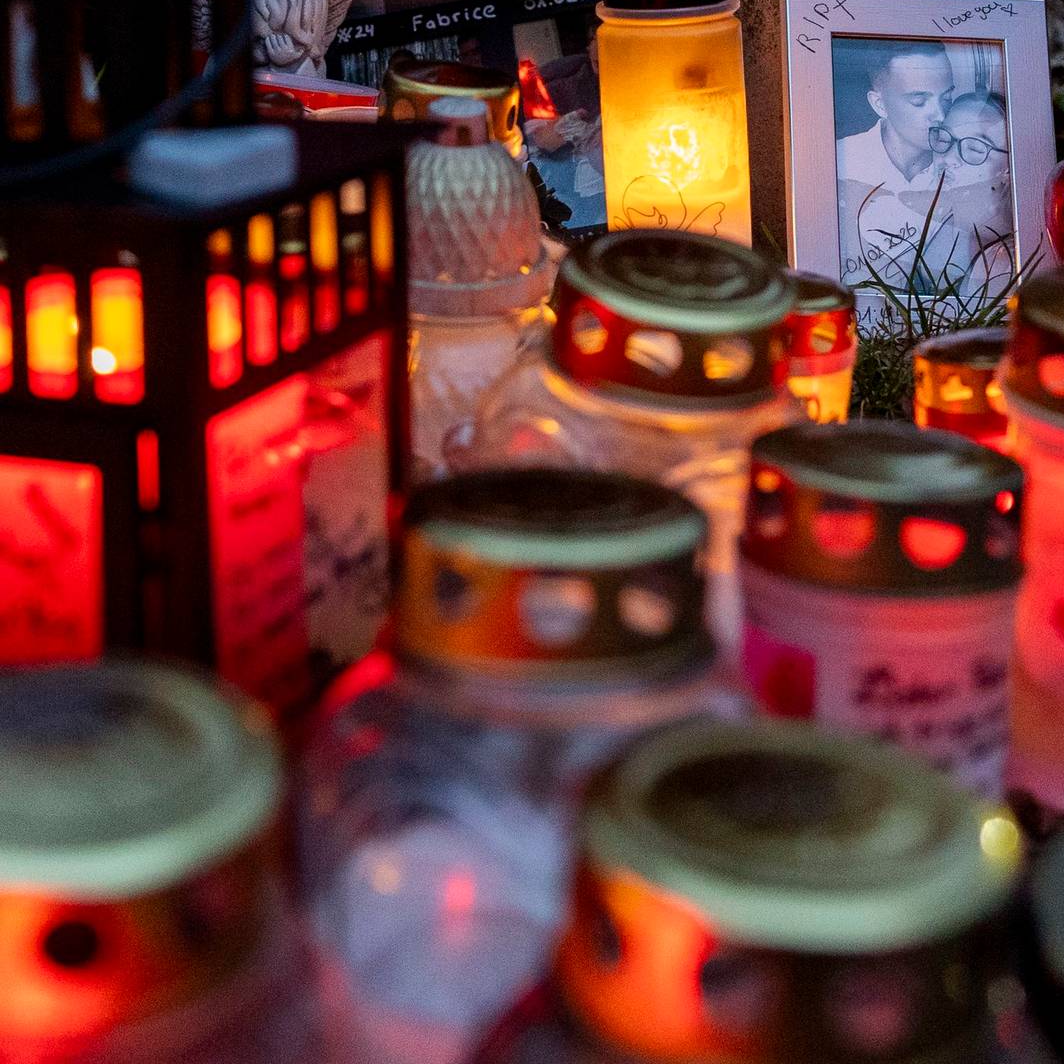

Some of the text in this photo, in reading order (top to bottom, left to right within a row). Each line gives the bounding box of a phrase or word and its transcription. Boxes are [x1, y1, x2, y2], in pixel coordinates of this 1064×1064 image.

[412, 3, 497, 33] Fabrice
[943, 8, 973, 28] love
[975, 1, 1002, 20] you
